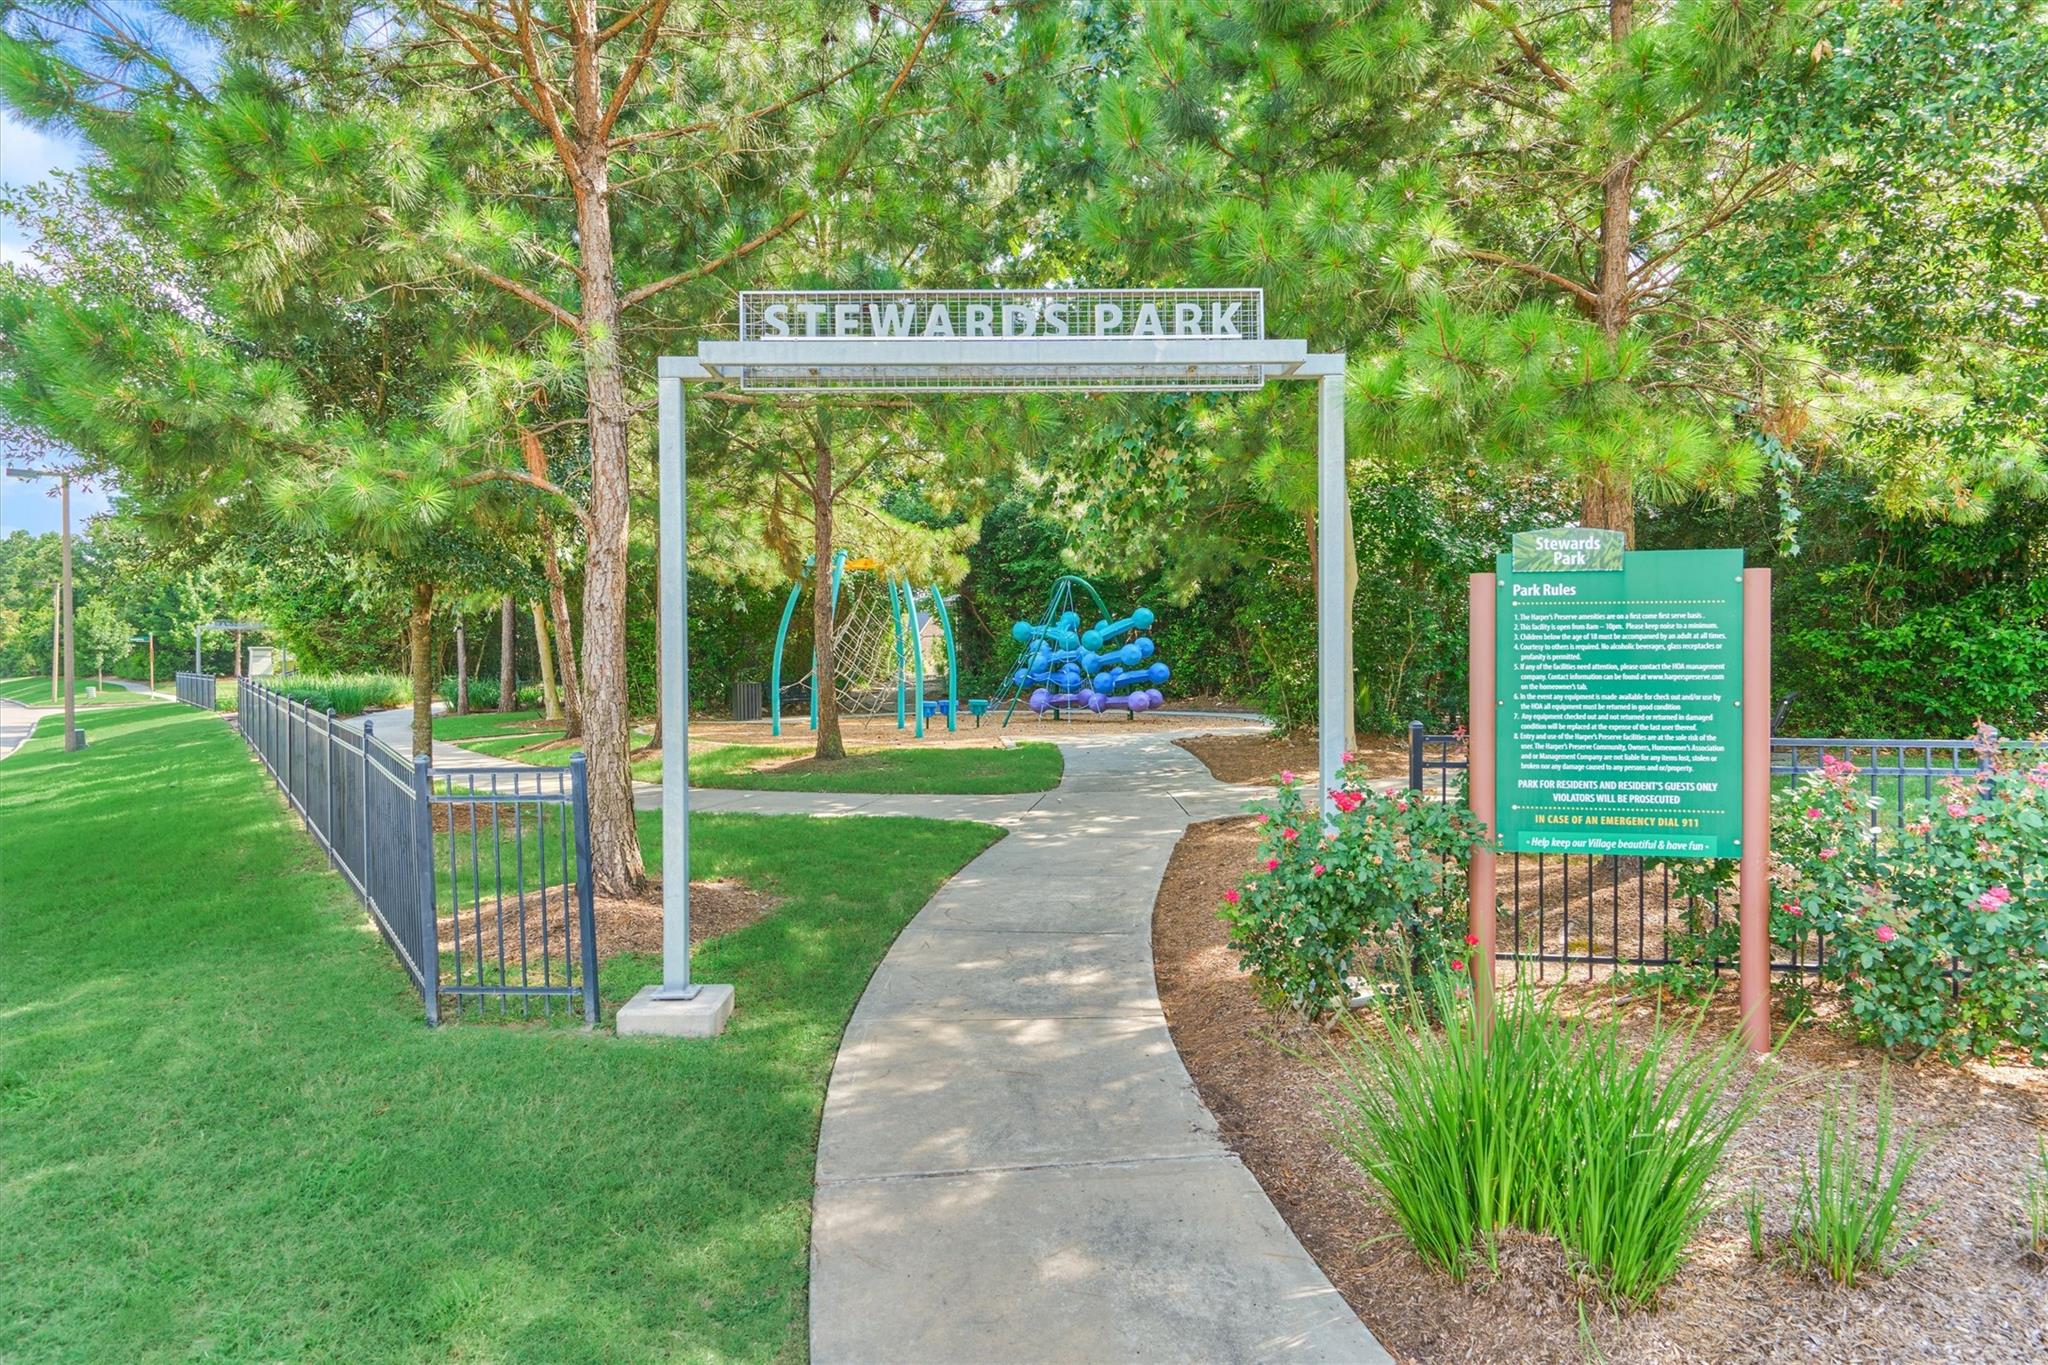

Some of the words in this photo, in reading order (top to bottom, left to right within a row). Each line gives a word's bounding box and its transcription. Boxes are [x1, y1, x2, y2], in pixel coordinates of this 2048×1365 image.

[764, 303, 1068, 337] STEWARDS
[1095, 302, 1243, 336] PARK
[1535, 536, 1601, 550] Stewards
[1553, 551, 1586, 565] Park
[1512, 584, 1541, 596] Park
[1543, 583, 1576, 596] Rules
[1531, 614, 1553, 622] Harper's
[1532, 624, 1550, 632] facility
[1606, 623, 1624, 631] 10pm.
[1645, 623, 1658, 631] keep
[1635, 643, 1666, 651] beverages,
[1667, 643, 1682, 651] glass
[1683, 643, 1715, 651] receptacles
[1552, 703, 1582, 711] equipment
[1638, 704, 1653, 712] good
[1522, 713, 1532, 721] Any
[1533, 713, 1563, 721] equipment
[1686, 714, 1713, 722] damaged
[1567, 723, 1590, 731] replaced
[1520, 733, 1535, 741] Entry
[1545, 743, 1567, 751] Harper's
[1593, 744, 1627, 752] Community,
[1628, 744, 1651, 752] Owners,
[1651, 744, 1690, 752] Homeowner's
[1539, 753, 1576, 761] Management
[1576, 754, 1602, 762] Company
[1678, 755, 1691, 763] lost,
[1562, 763, 1584, 771] damage
[1518, 779, 1538, 788] PARK
[1540, 779, 1554, 788] FOR
[1556, 780, 1598, 789] RESIDENTS
[1600, 781, 1616, 790] AND
[1618, 781, 1663, 791] RESIDENT'S
[1665, 782, 1695, 791] GUESTS
[1696, 782, 1718, 792] ONLY
[1553, 792, 1595, 802] VIOLATORS
[1596, 793, 1616, 802] WILL
[1617, 794, 1628, 803] BE
[1629, 794, 1680, 804] PROSECUTED
[1535, 815, 1545, 823] IN
[1548, 815, 1569, 824] CASE
[1571, 816, 1583, 824] OF
[1586, 816, 1598, 825] AN
[1600, 816, 1655, 826] EMERGENCY
[1658, 818, 1679, 827] DIAL
[1682, 818, 1698, 827] 911
[1531, 837, 1550, 848] Help
[1551, 837, 1571, 849] keep
[1588, 838, 1616, 851] Village
[1618, 839, 1657, 849] beautiful
[1658, 841, 1665, 849] &
[1666, 840, 1687, 850] have
[1688, 841, 1704, 851] fun
